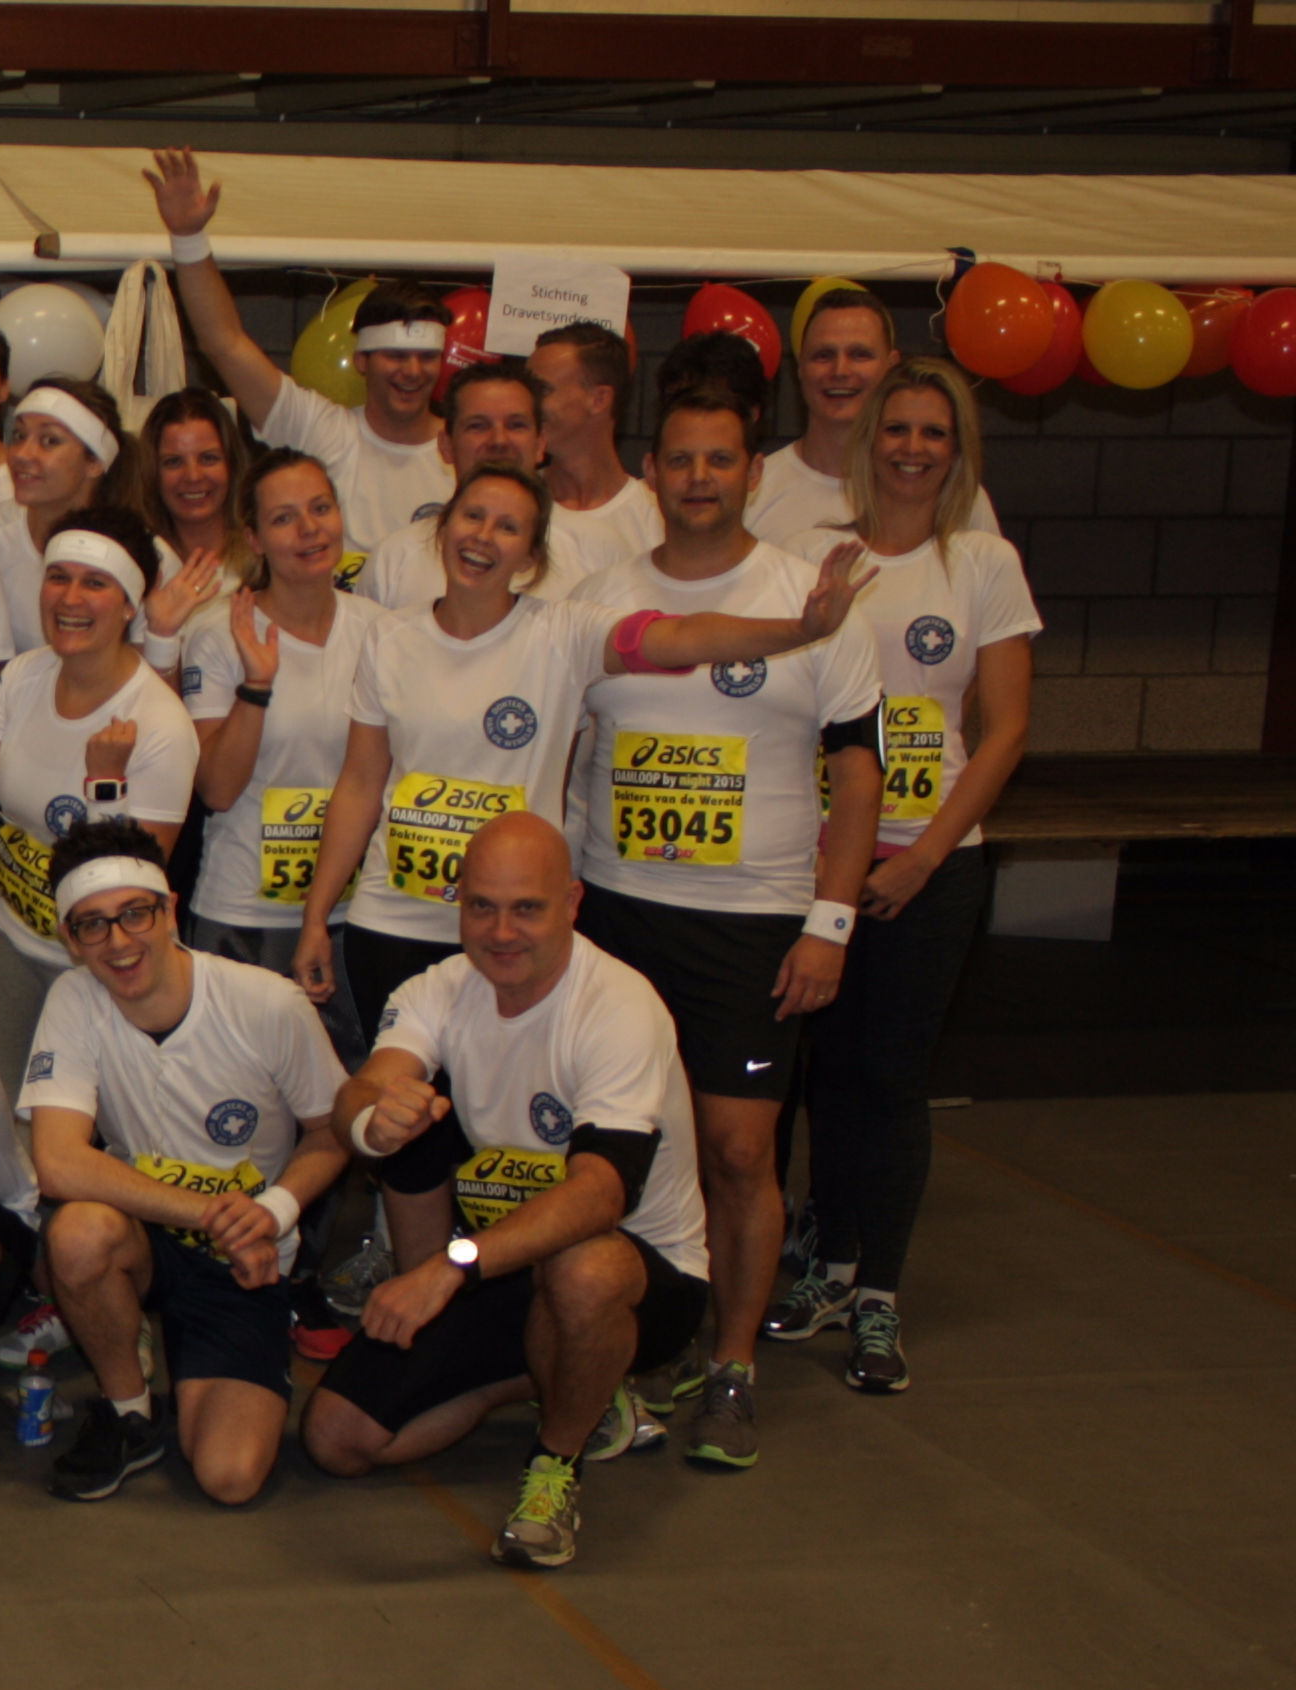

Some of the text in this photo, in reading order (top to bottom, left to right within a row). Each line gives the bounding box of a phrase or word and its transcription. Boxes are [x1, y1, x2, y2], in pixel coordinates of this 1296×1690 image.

[531, 284, 589, 306] Stichting
[887, 707, 920, 725] ics
[912, 734, 941, 746] 2015
[658, 745, 722, 766] asics
[900, 752, 941, 762] Wereld
[614, 770, 661, 784] DAMLOOP
[662, 773, 677, 788] by
[713, 777, 743, 788] 2015
[446, 788, 510, 813] asics
[615, 790, 743, 807] Dokters van de Wereld
[391, 808, 447, 827] DAMLOOP
[449, 815, 463, 831] by
[619, 806, 733, 844] 53045
[264, 825, 318, 838] DAMLOOP
[390, 827, 461, 846] Dokters van
[18, 843, 50, 869] asic
[264, 844, 308, 854] Dokters
[396, 845, 463, 884] 530
[502, 1158, 556, 1183] asics
[457, 1180, 523, 1203] DAMLOOP by
